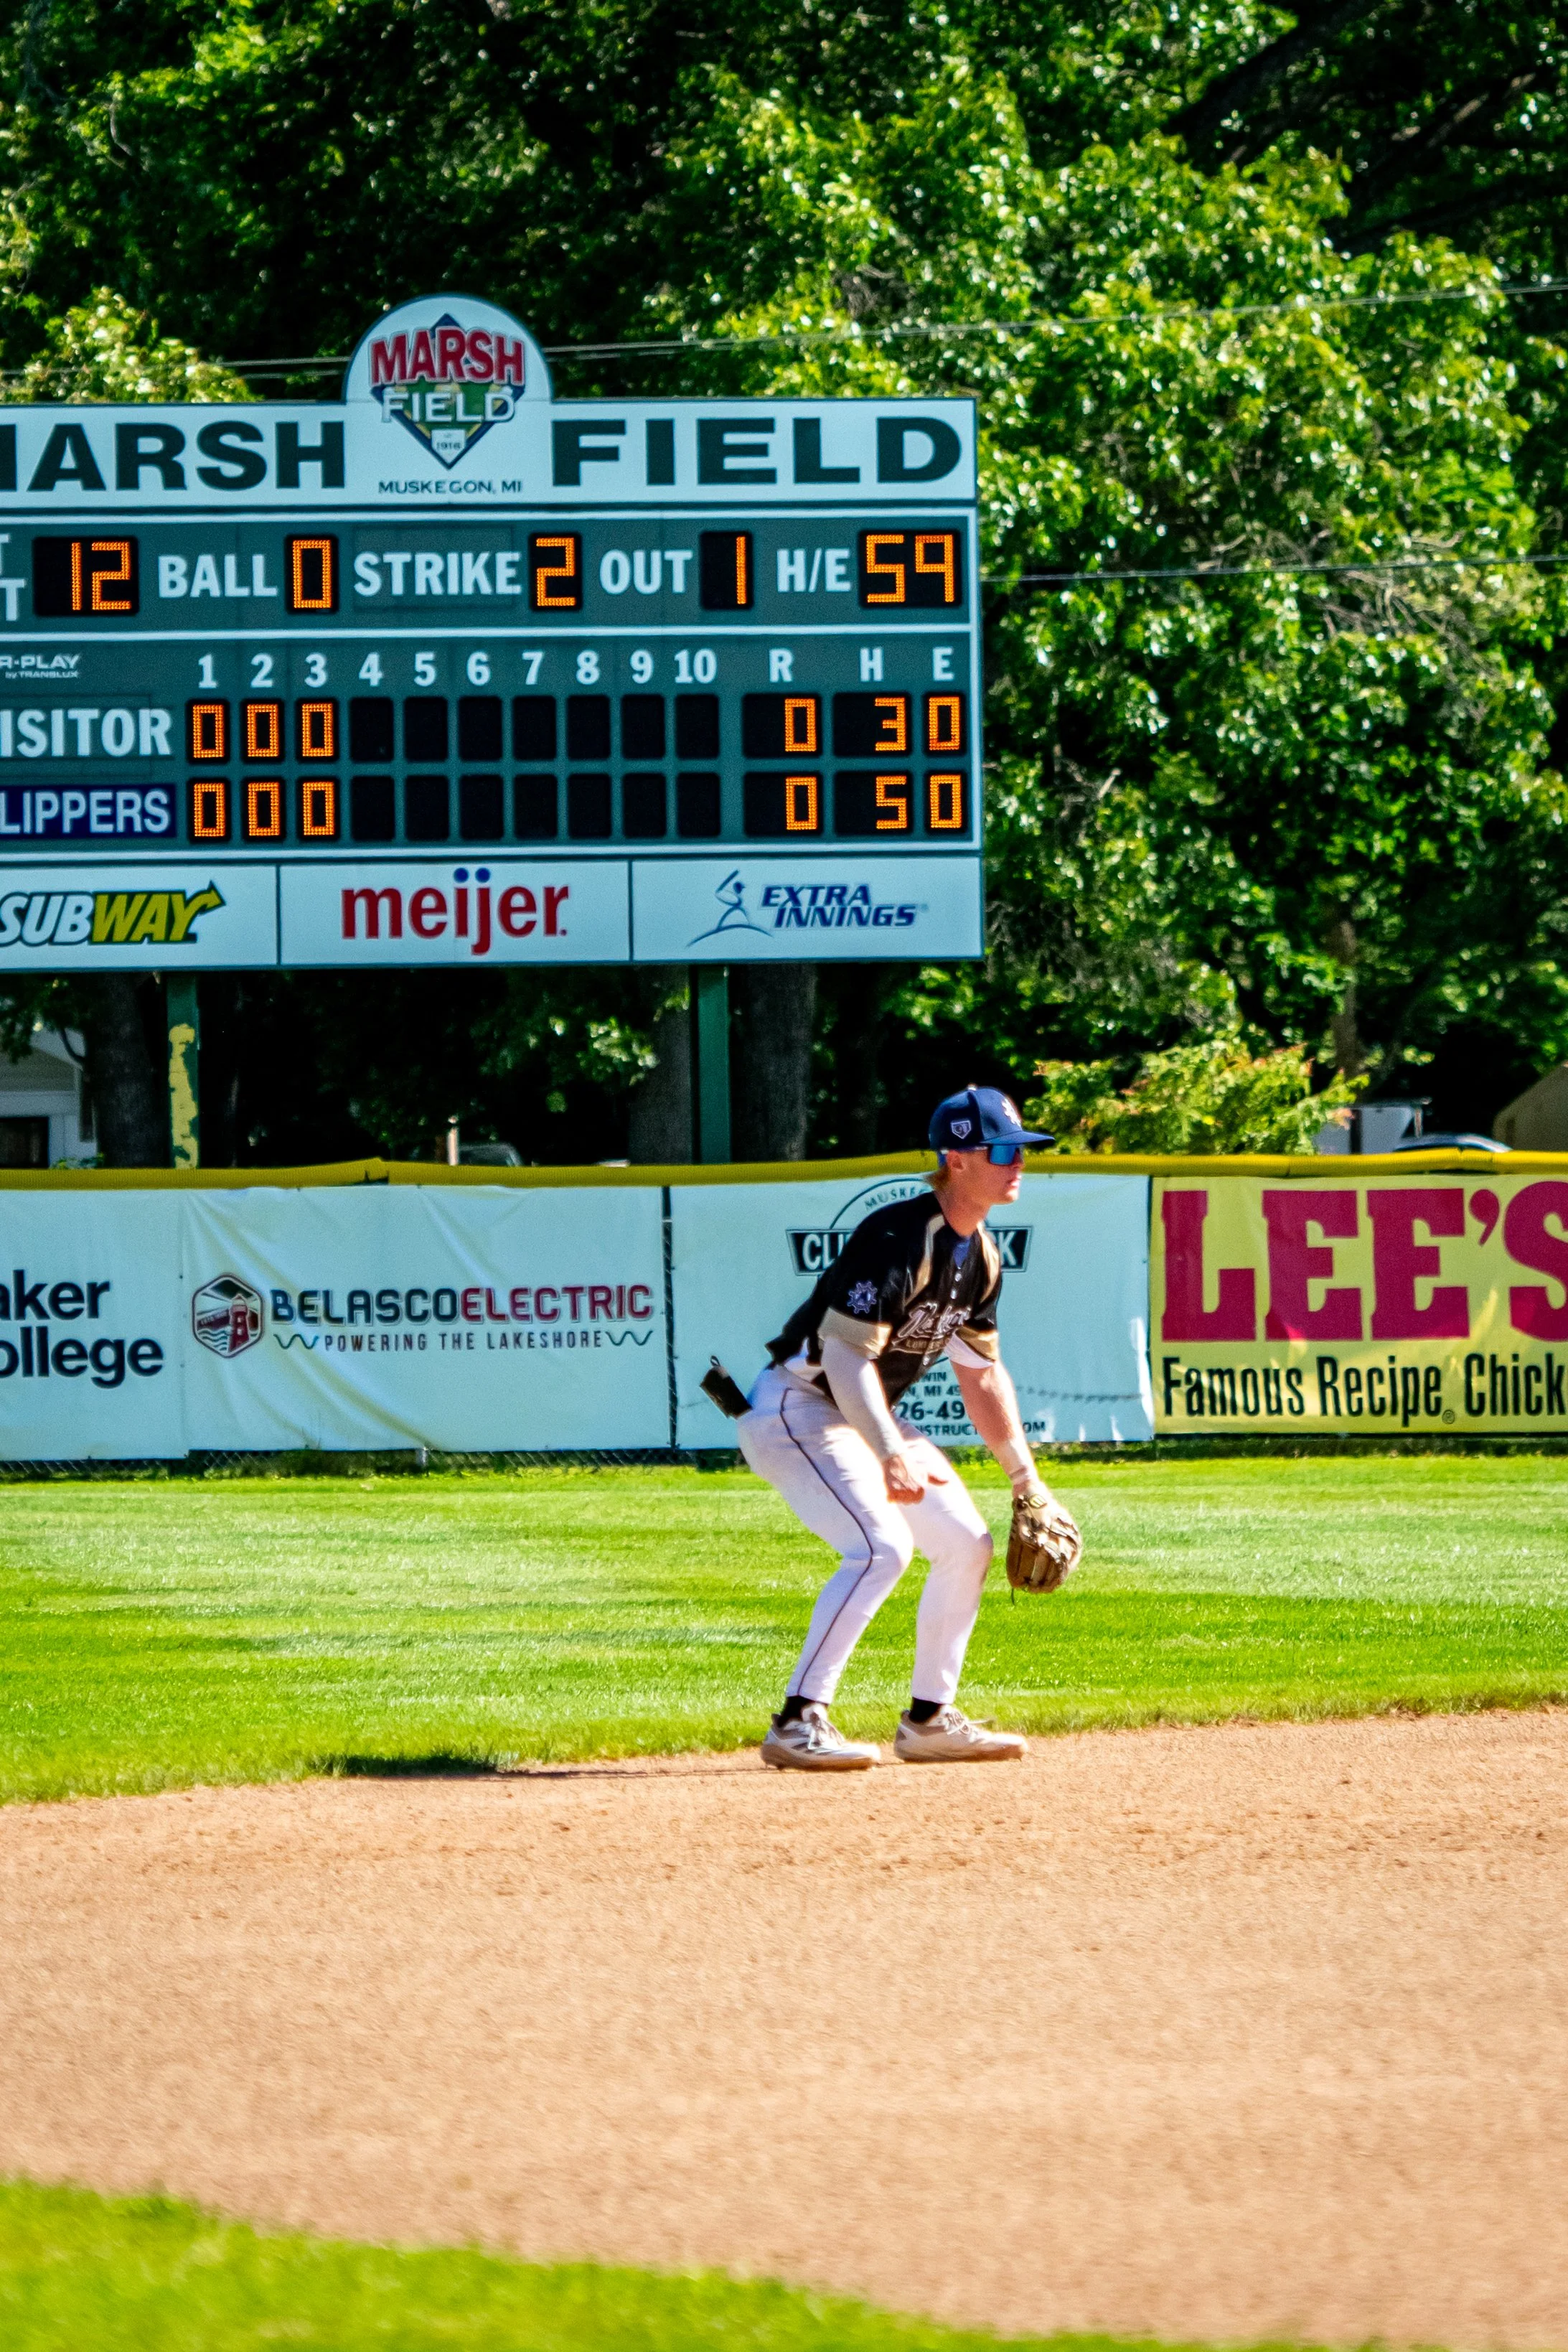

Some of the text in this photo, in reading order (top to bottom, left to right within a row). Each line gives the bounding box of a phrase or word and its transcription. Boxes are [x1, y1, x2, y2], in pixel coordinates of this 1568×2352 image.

[370, 327, 525, 386] MARSH
[382, 388, 516, 423] FIELD
[0, 416, 962, 492] ARSH FIELD
[378, 480, 522, 495] MUSKEGON, MI
[71, 541, 131, 612] 12
[157, 553, 278, 599] BALL
[292, 540, 332, 609] 0
[354, 551, 522, 596] STRIKE
[535, 537, 576, 606] 2
[598, 549, 693, 594] OUT
[736, 536, 746, 605] 1
[776, 548, 852, 593] H/E
[865, 534, 954, 603] 59
[197, 647, 955, 689] 1 2 3 4 5 6 7 8 9 10 R H E
[192, 704, 225, 759] 0
[246, 703, 279, 758] 0
[301, 703, 334, 757] 0
[784, 698, 817, 752] 0
[875, 697, 906, 751] 3
[928, 697, 960, 751] 0
[193, 782, 226, 837] 0
[248, 782, 281, 836] 0
[302, 782, 335, 836] 0
[785, 777, 817, 830] 0
[875, 776, 908, 830] 5
[929, 775, 962, 829] 0
[0, 883, 224, 947] SUBWAY
[761, 885, 872, 907] EXTRA
[774, 905, 916, 928] INNINGS
[1161, 1181, 1568, 1342] LEE'S
[324, 1330, 602, 1353] POWERING THE LAKESHORE
[1162, 1353, 1567, 1428] Famous Recipe Chick
